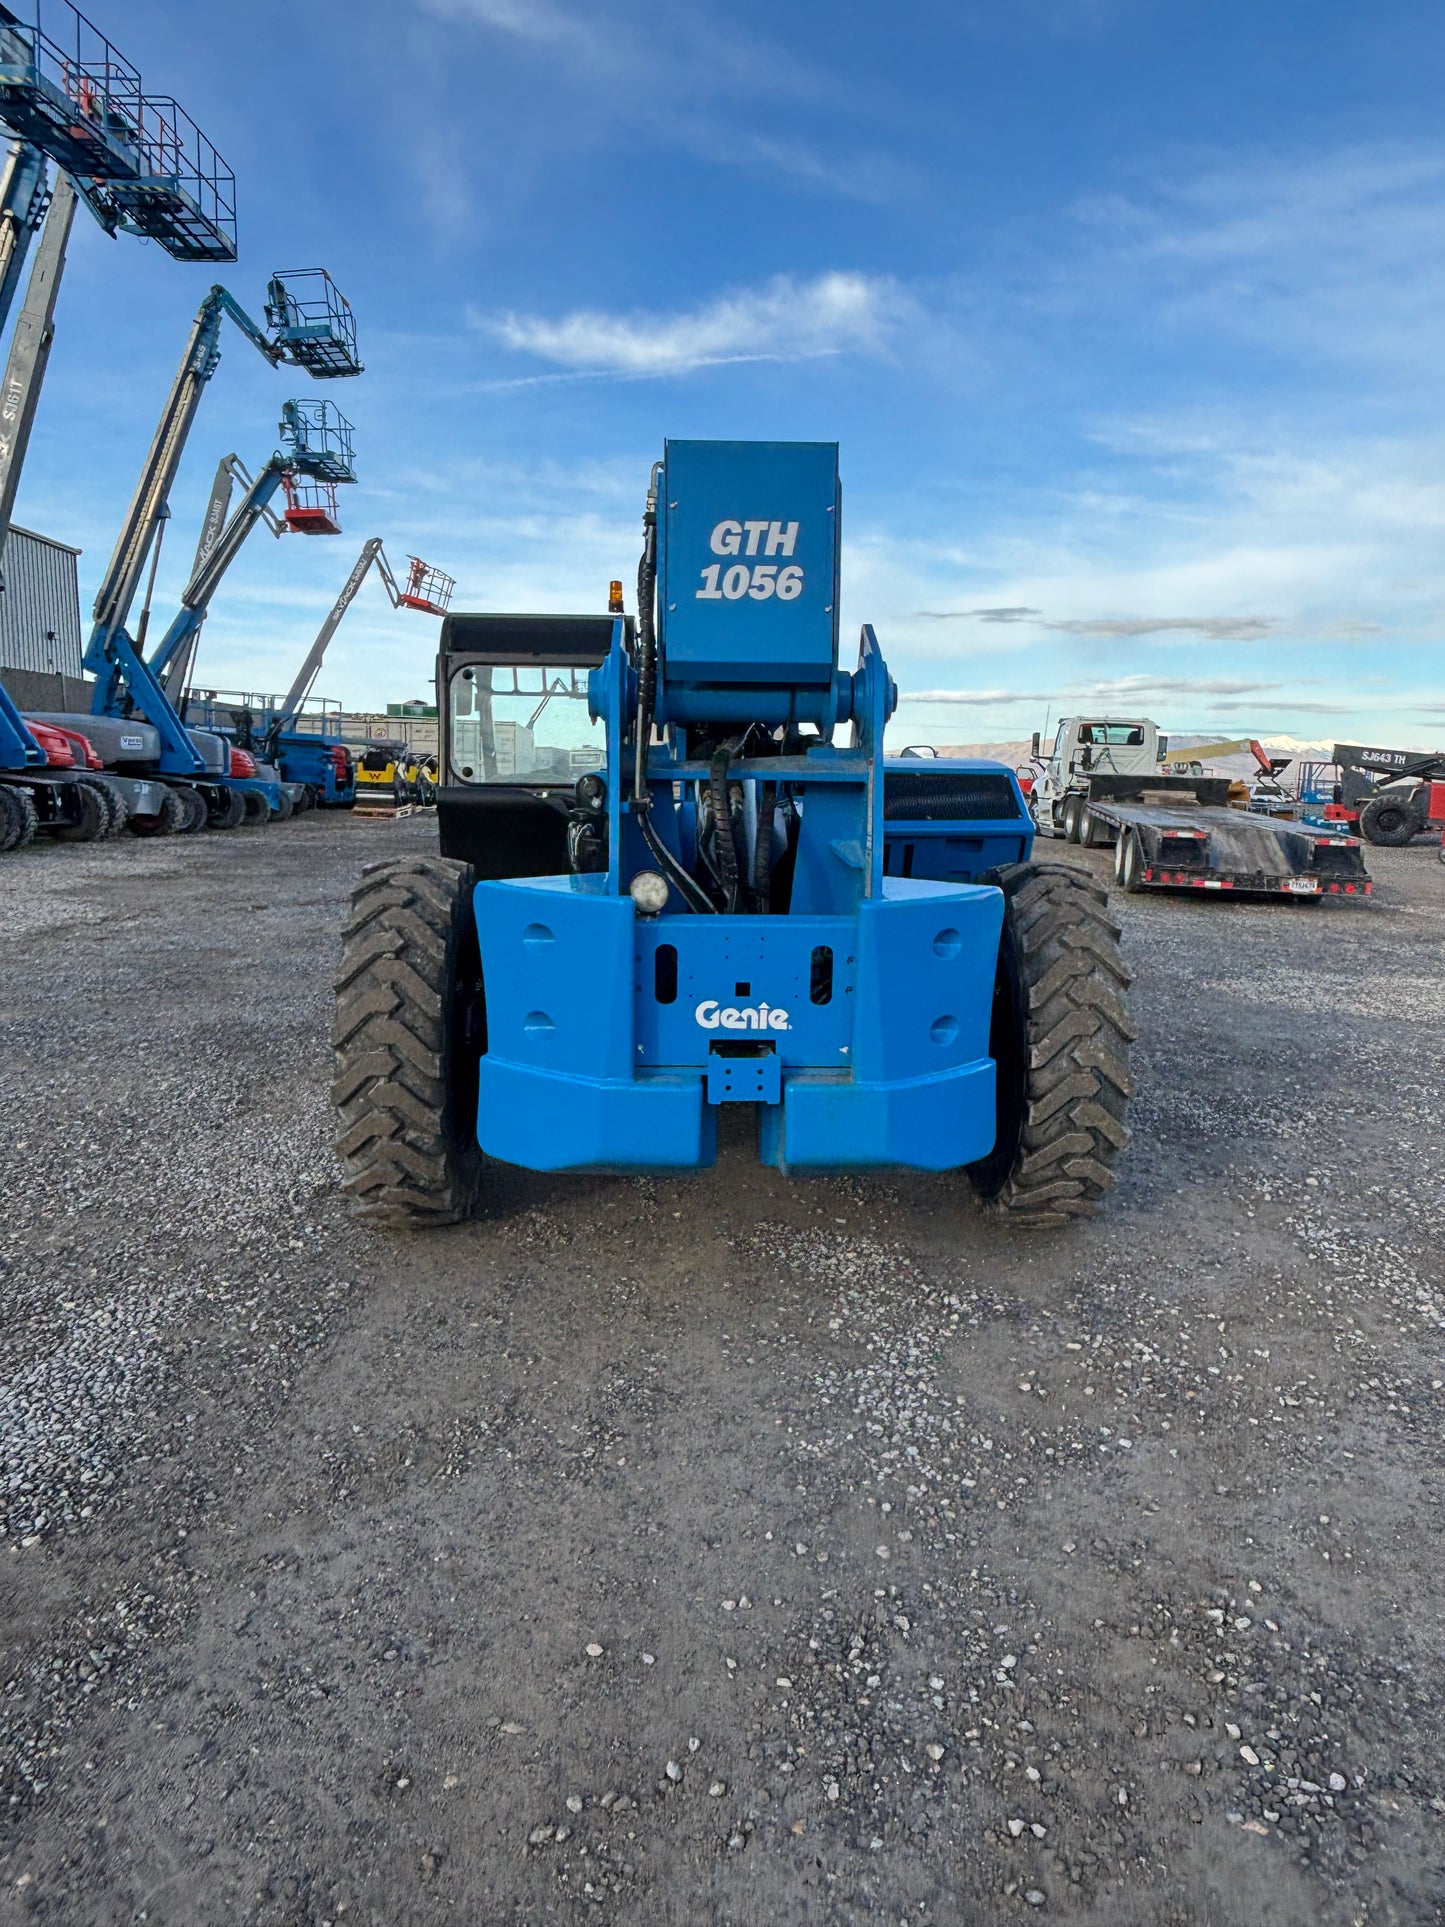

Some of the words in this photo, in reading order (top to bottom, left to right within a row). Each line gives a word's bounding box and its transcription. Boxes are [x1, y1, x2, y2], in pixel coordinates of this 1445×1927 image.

[710, 520, 799, 556] GTH
[696, 564, 804, 600] 1056
[1361, 751, 1392, 763] SJ643
[1394, 754, 1406, 765] TH
[695, 1000, 790, 1030] Genie
